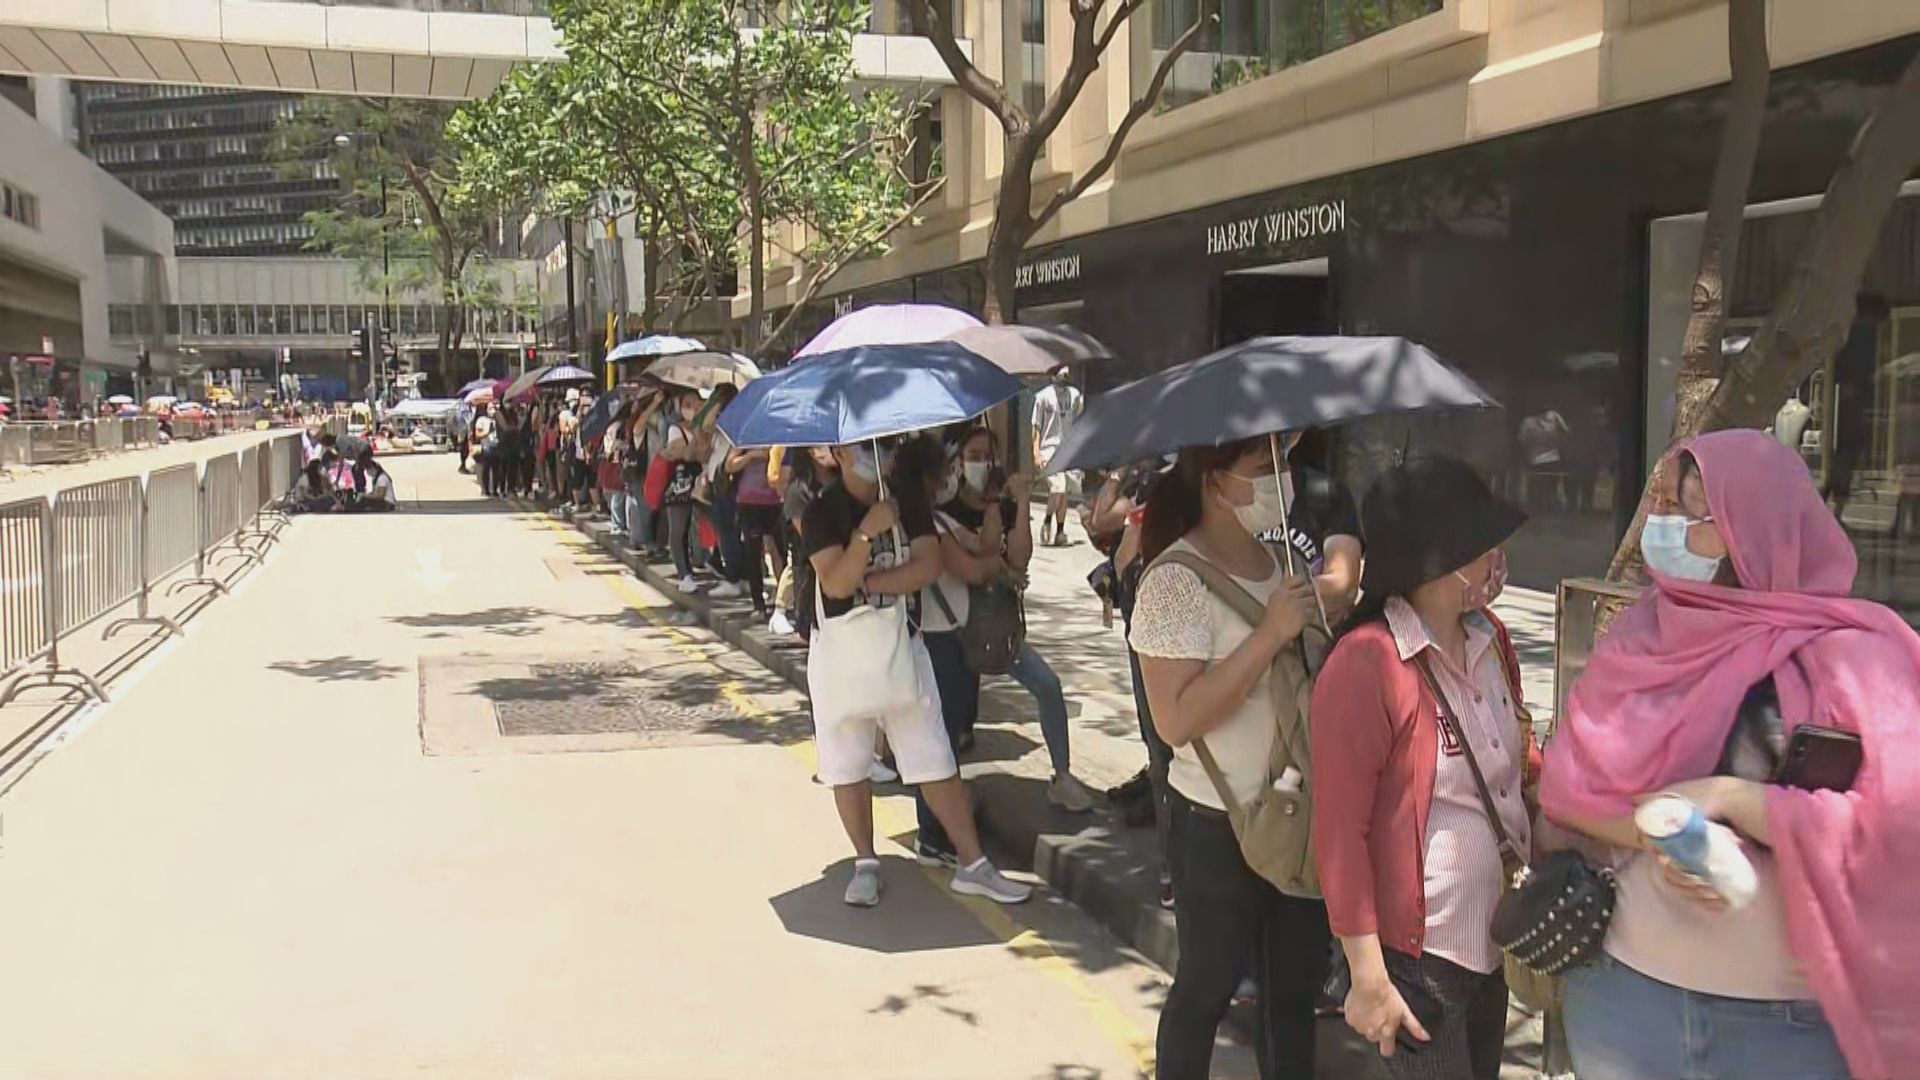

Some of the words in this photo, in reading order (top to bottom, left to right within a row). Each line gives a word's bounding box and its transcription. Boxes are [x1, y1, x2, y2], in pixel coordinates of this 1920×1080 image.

[1206, 217, 1259, 255] HARRY
[1263, 199, 1345, 243] WINSTON
[1014, 264, 1034, 288] RRY
[1035, 254, 1080, 283] WINSTON
